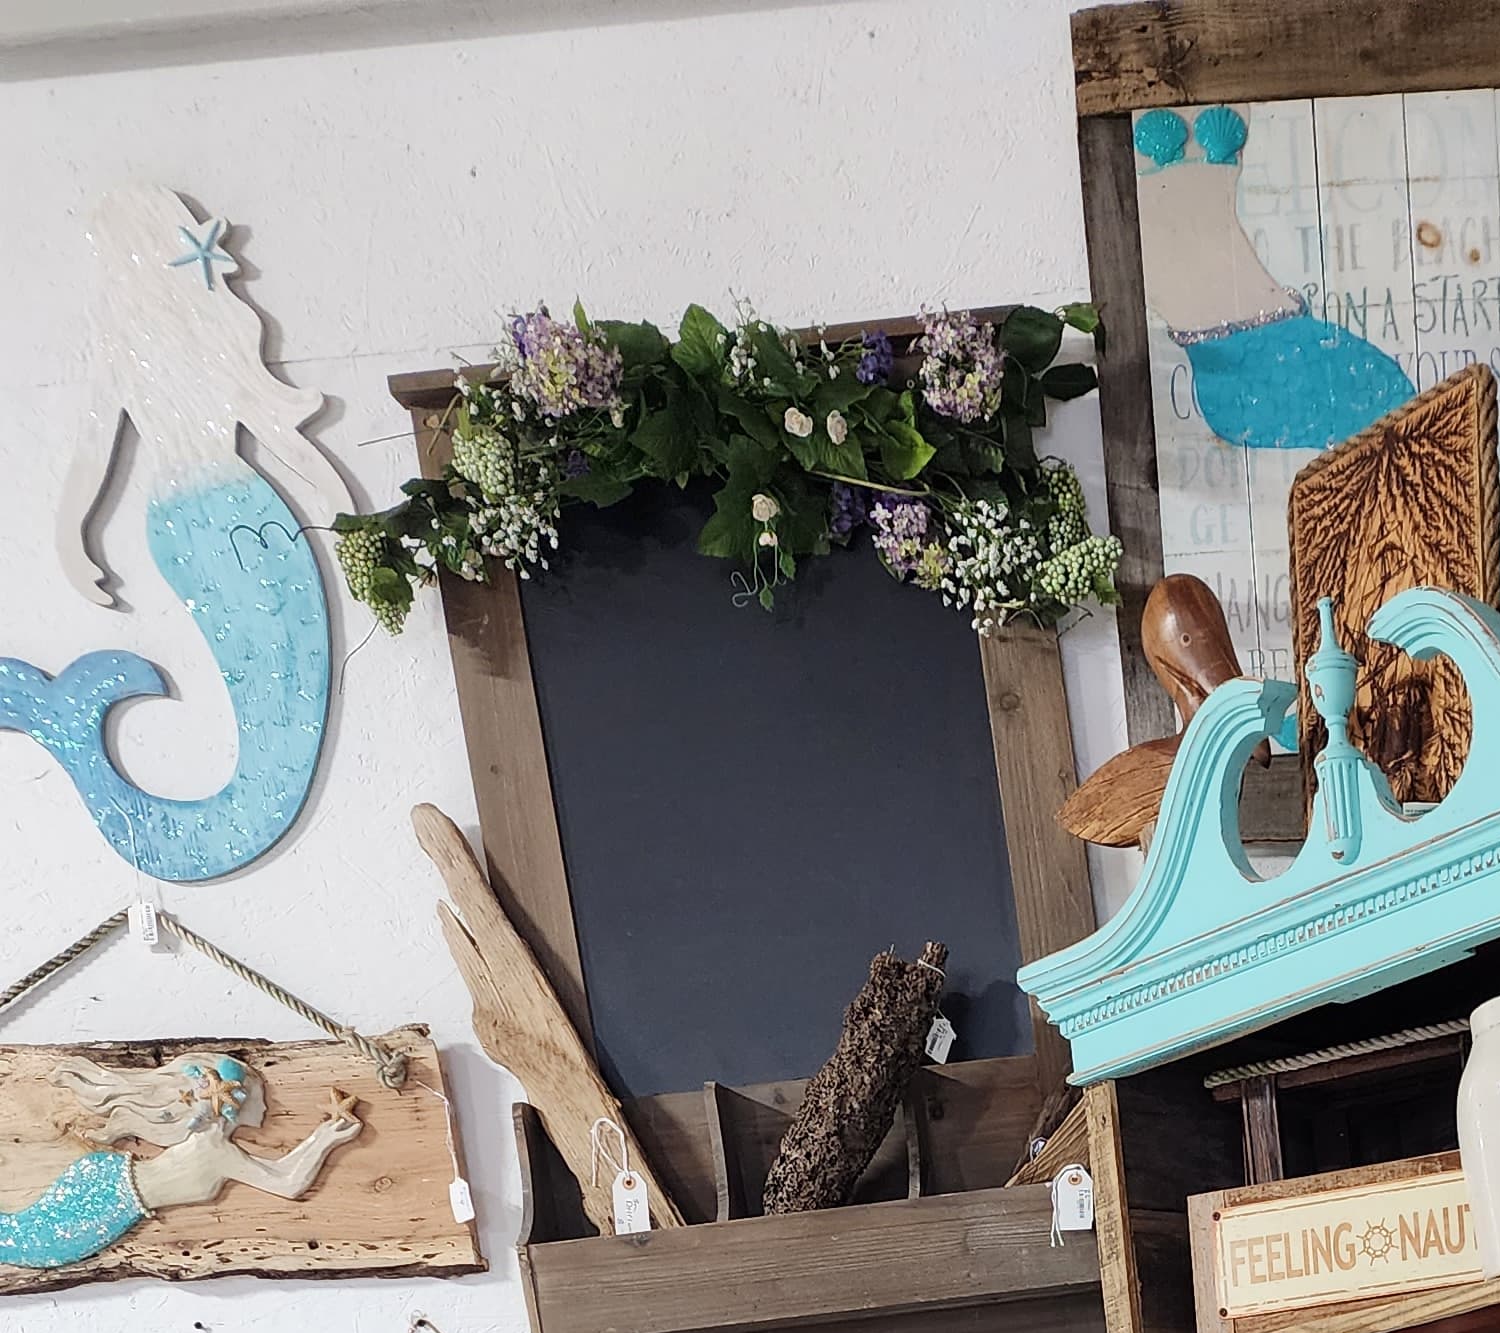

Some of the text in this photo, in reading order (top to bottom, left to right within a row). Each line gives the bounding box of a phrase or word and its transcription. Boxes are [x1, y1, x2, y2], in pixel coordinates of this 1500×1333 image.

[1294, 222, 1367, 274] THE
[1391, 214, 1500, 273] BEACH
[1382, 286, 1400, 341] A
[1230, 1221, 1356, 1288] FEELING
